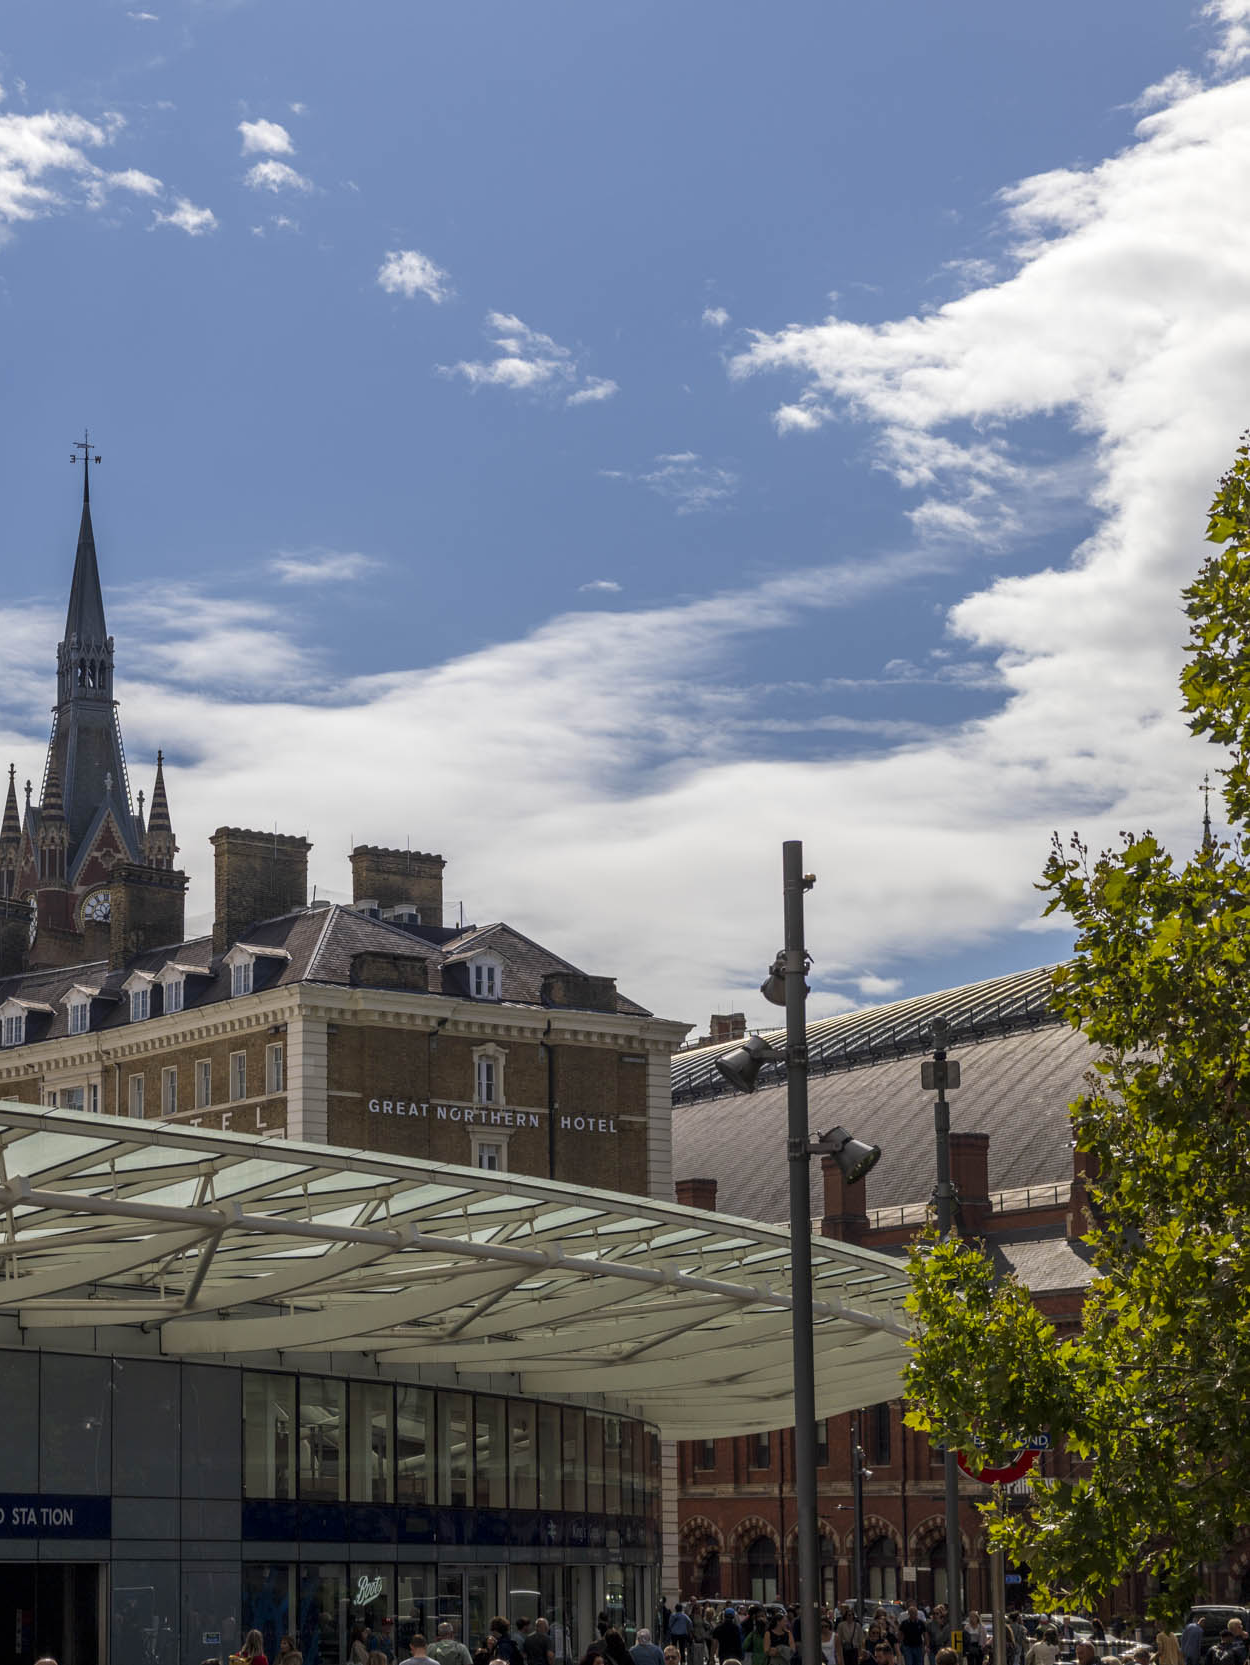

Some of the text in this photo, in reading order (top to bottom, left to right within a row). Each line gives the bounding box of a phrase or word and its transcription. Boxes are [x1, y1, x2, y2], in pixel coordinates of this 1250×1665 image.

[368, 1099, 618, 1133] GREAT NORTHERN HOTEL
[12, 1507, 74, 1526] STATION
[353, 1575, 382, 1606] Boots
